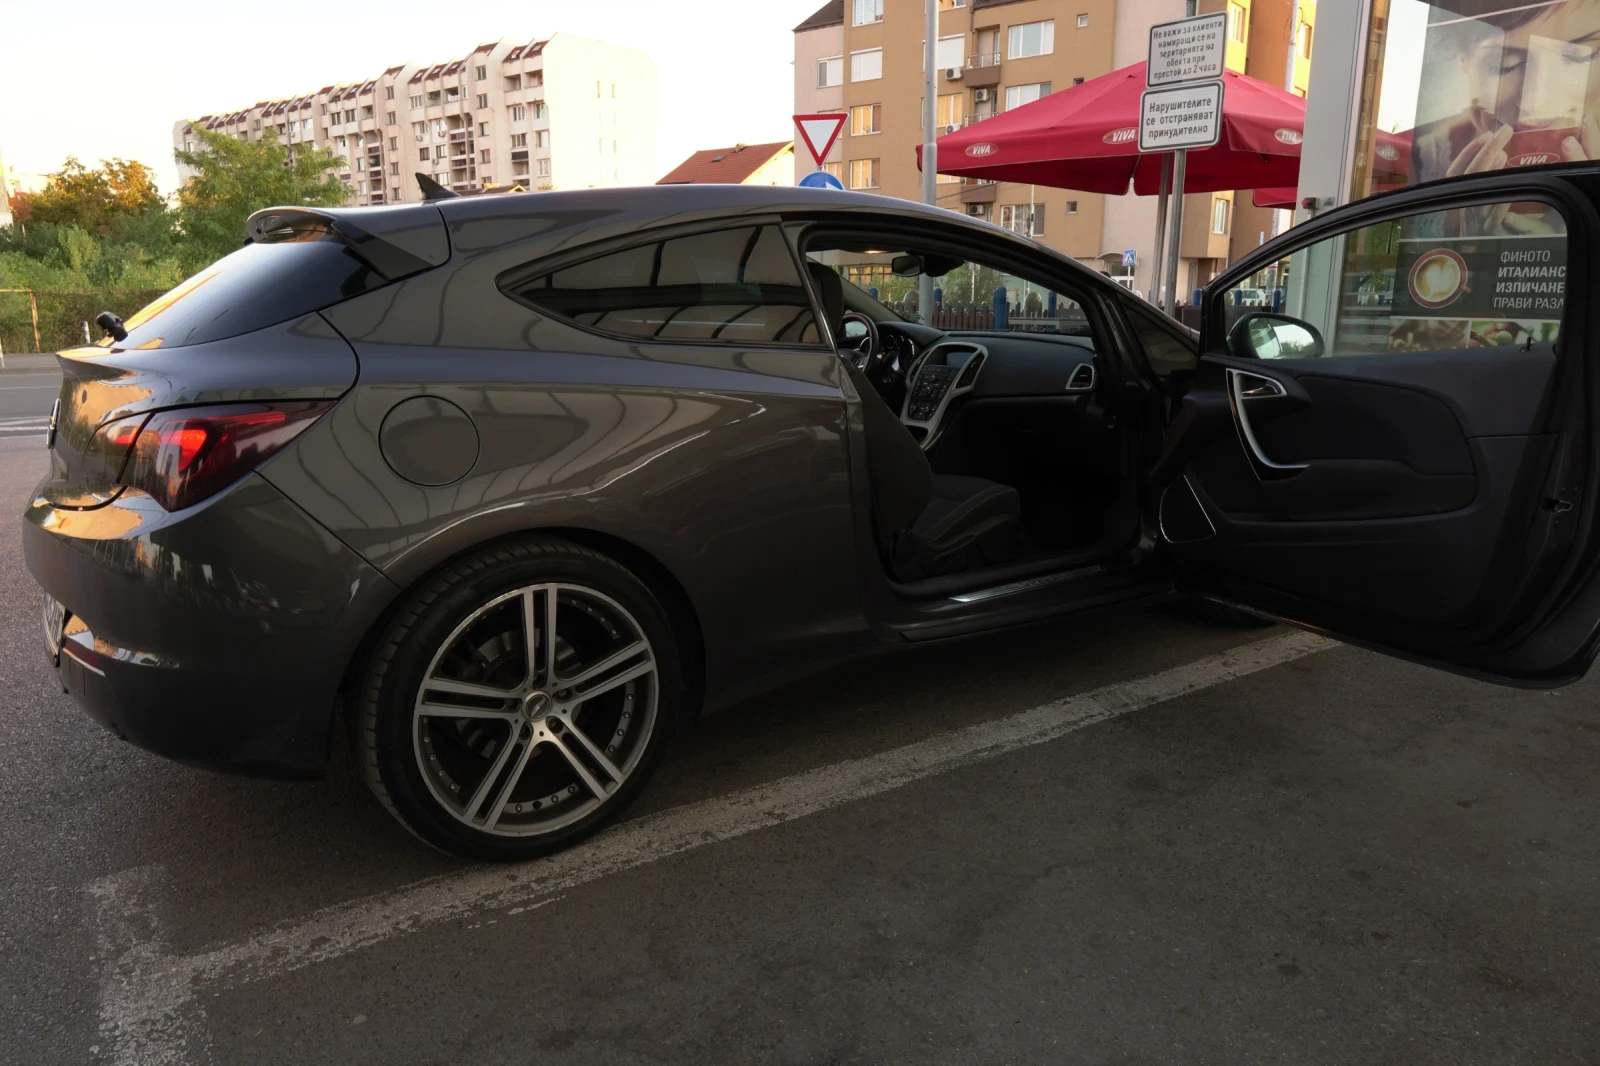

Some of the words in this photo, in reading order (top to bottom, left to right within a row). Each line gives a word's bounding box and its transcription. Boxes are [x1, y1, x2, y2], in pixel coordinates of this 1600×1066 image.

[1153, 30, 1162, 39] Не
[1163, 28, 1181, 38] важи
[1183, 26, 1191, 34] за
[1193, 20, 1223, 32] клиенти
[1158, 35, 1195, 48] намиращи
[1197, 34, 1205, 42] се
[1207, 32, 1216, 40] на
[1160, 44, 1204, 59] територията
[1166, 57, 1191, 67] обекта
[1192, 55, 1205, 65] при
[1154, 68, 1181, 80] престой
[1183, 67, 1191, 76] до
[1193, 64, 1198, 74] 2
[1199, 63, 1216, 72] часа
[1149, 98, 1212, 114] Нарушителите
[1146, 117, 1156, 126] се
[1159, 111, 1213, 125] отстраняват
[1112, 129, 1136, 142] VIVA
[1148, 125, 1208, 140] принудително
[1281, 130, 1297, 143] VIVA
[972, 144, 991, 155] VIVA
[1520, 155, 1548, 165] VIVA
[1500, 250, 1551, 263] ФИНОТО
[1497, 266, 1566, 278] ИТАЛИАНС
[1495, 281, 1565, 293] ИЗПИЧАНЕ
[1493, 297, 1532, 309] ПРАВИ
